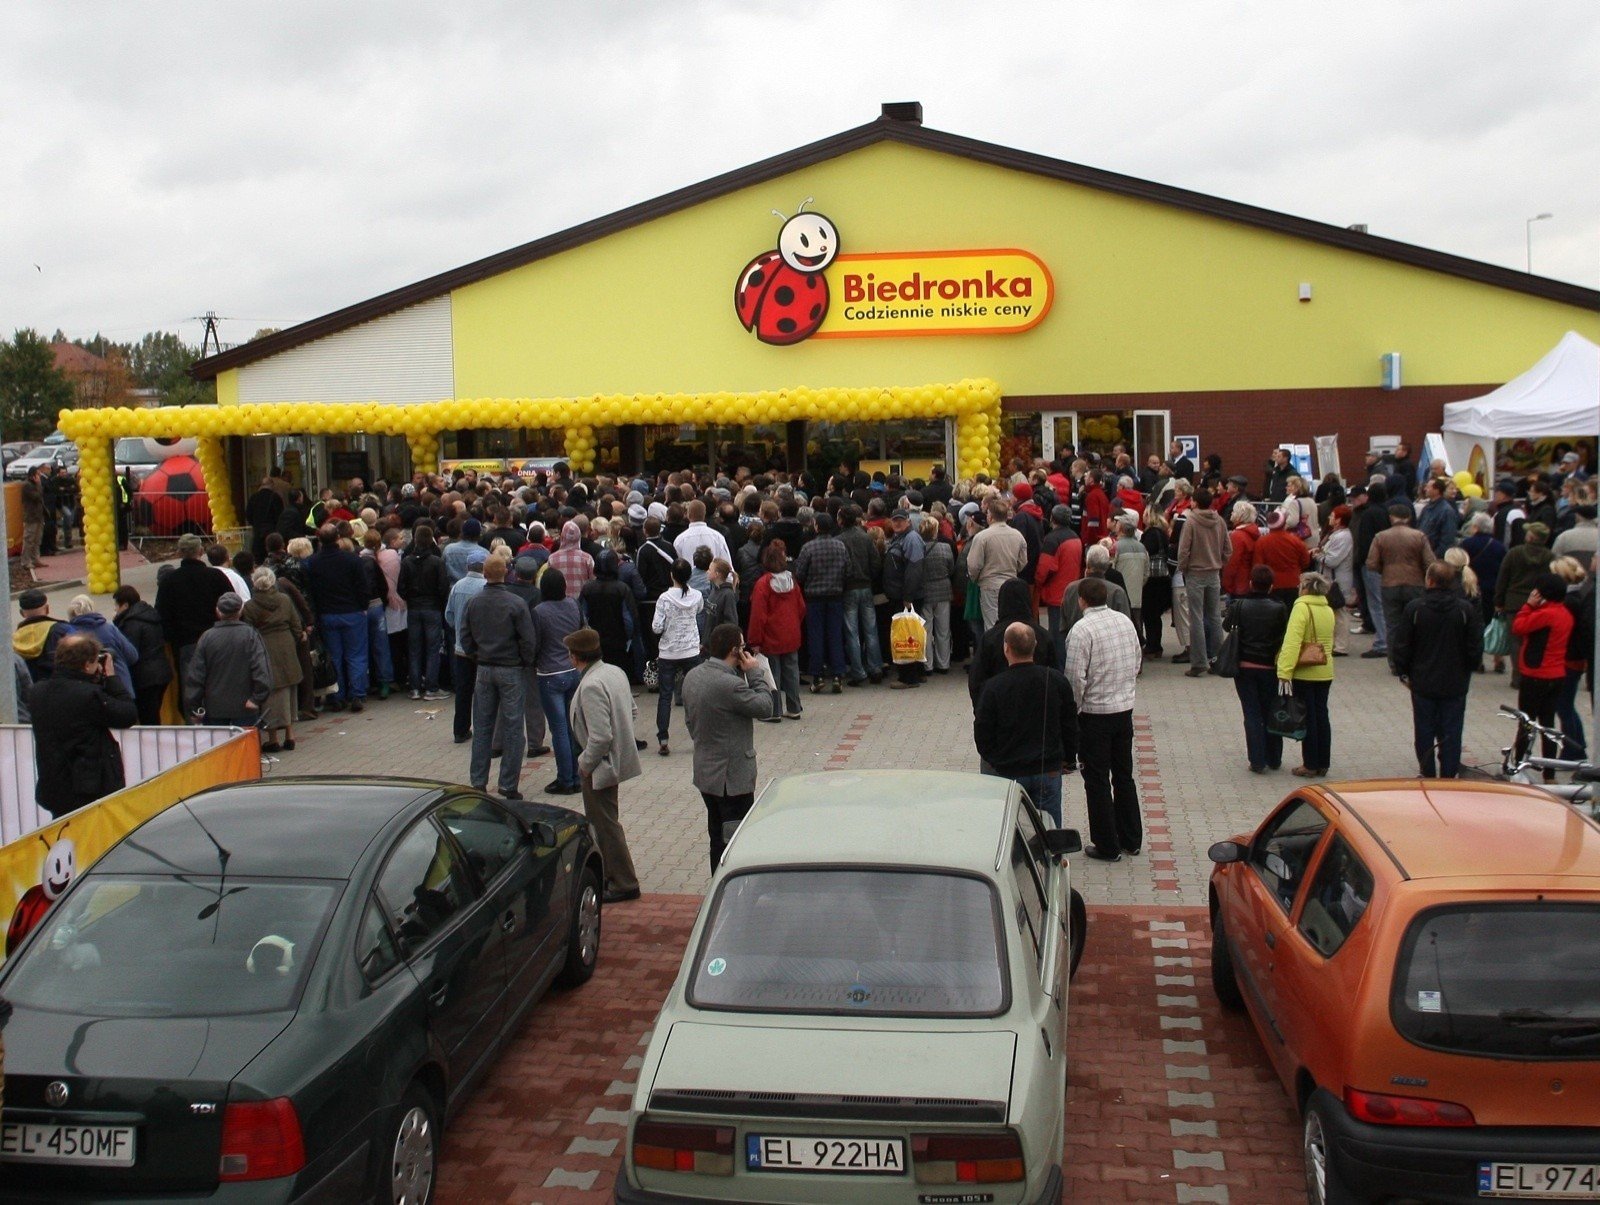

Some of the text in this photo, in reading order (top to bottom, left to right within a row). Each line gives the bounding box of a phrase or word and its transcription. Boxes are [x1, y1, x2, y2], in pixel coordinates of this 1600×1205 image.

[843, 269, 1032, 303] Biedronka
[844, 302, 1032, 321] Codziennie niskie ceny
[1180, 440, 1195, 457] P
[190, 1102, 217, 1114] TDI
[1, 1124, 129, 1157] EL 450MF
[764, 1138, 899, 1168] EL 922HA
[1496, 1165, 1600, 1192] EL 974
